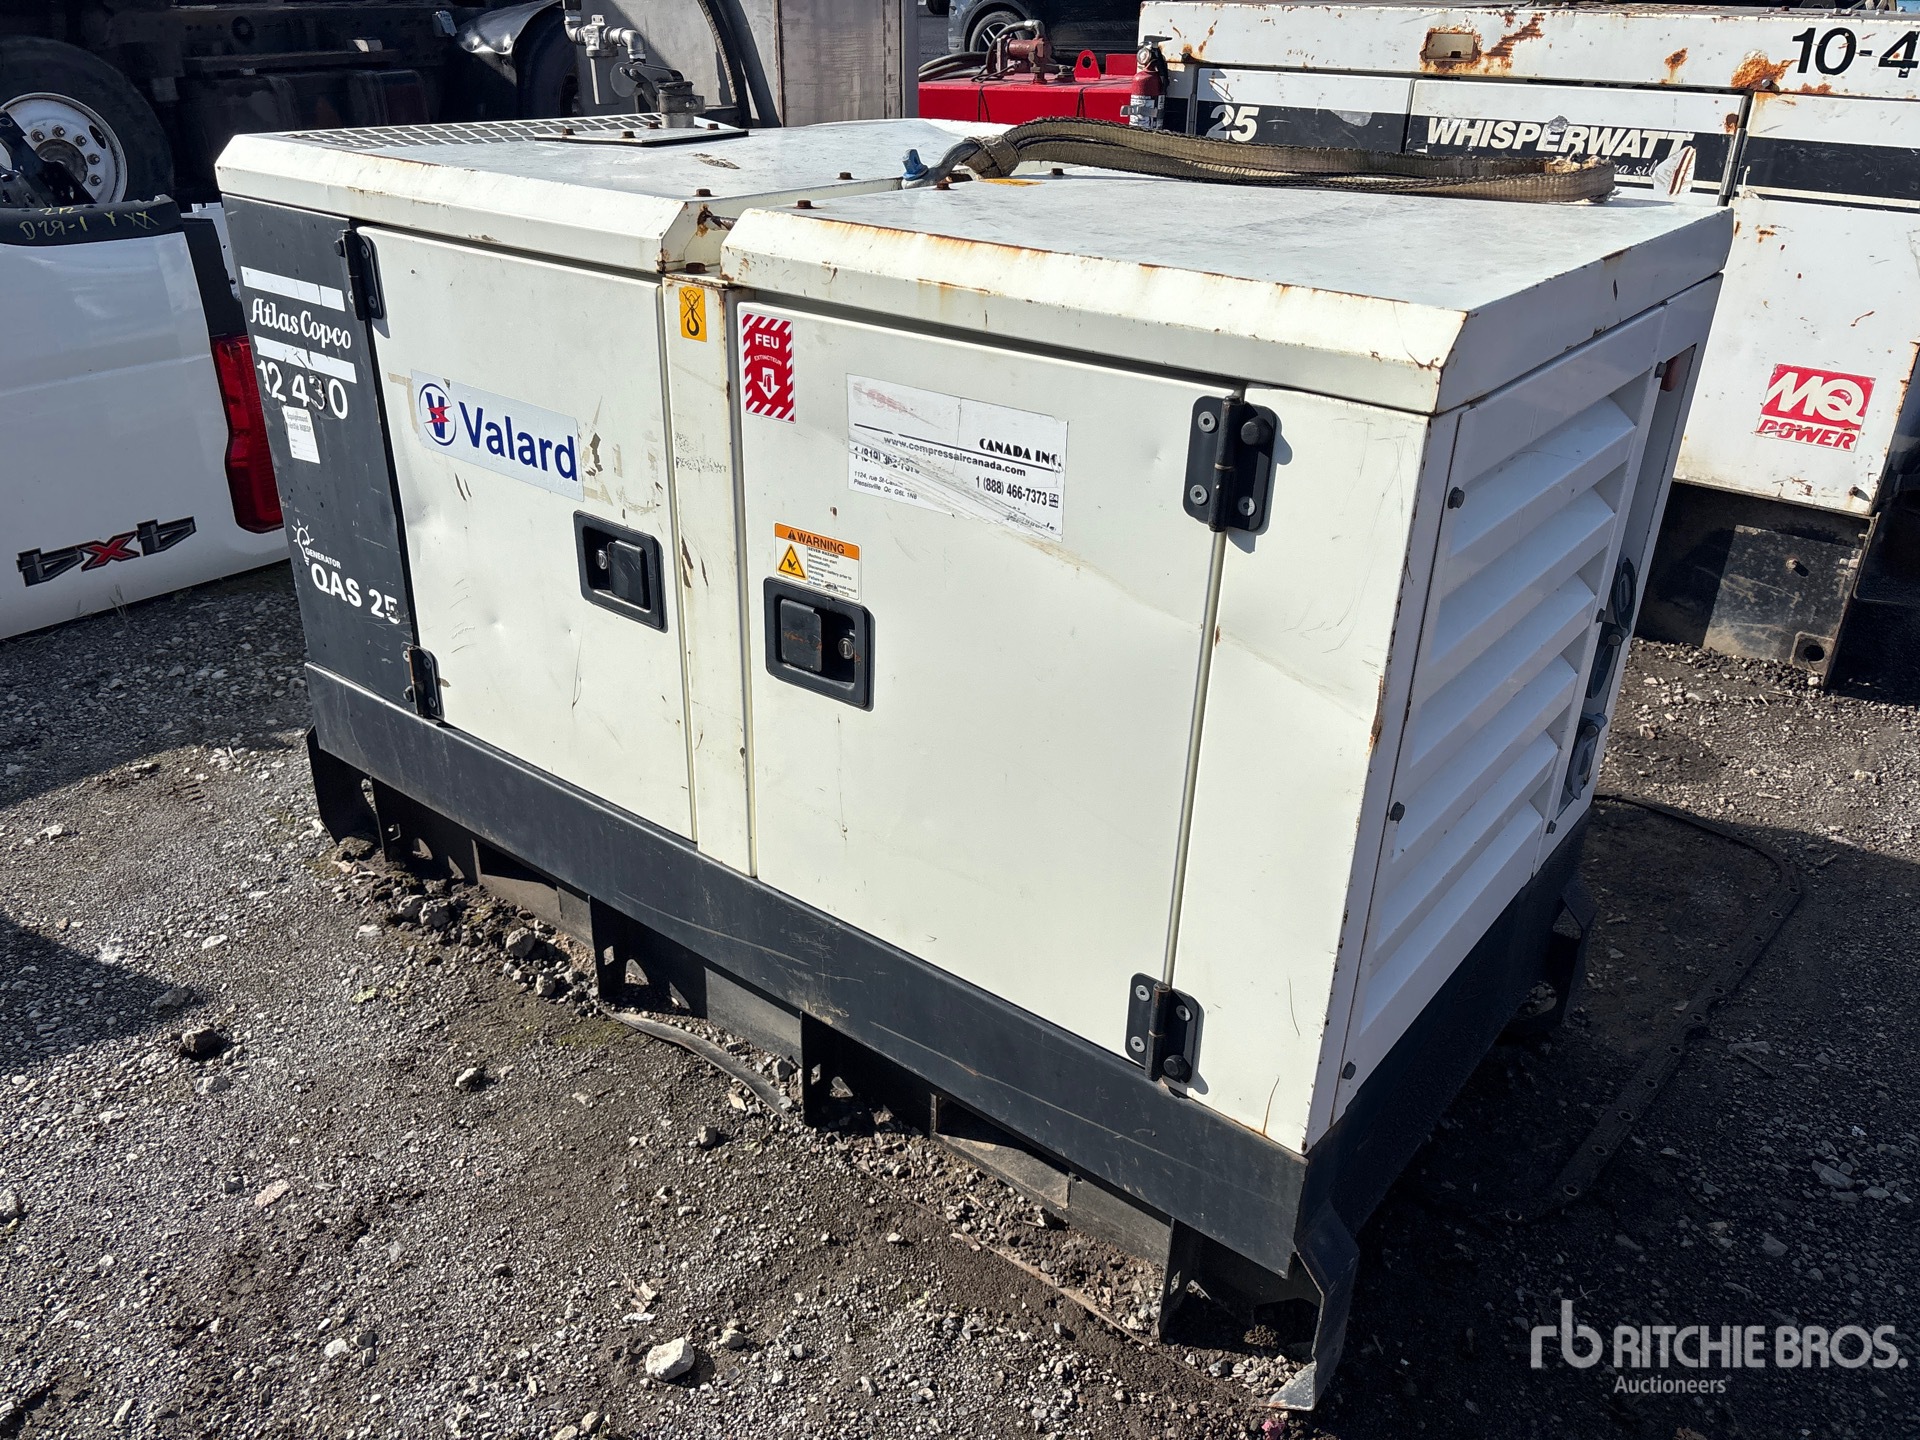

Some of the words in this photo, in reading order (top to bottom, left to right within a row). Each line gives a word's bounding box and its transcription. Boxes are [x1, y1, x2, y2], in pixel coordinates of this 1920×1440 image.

[1206, 104, 1260, 142] 25
[1427, 116, 1695, 159] WHISPERWATT
[250, 297, 299, 335] Atlas
[300, 310, 352, 349] Copco
[755, 333, 780, 349] FEU
[753, 354, 783, 366] EXTINCTEUR
[1762, 371, 1864, 425] MQ
[458, 401, 578, 481] Valard
[979, 437, 1032, 460] CANADA
[1755, 419, 1857, 450] POWER
[883, 437, 1026, 477] www.compressaircanada.com
[854, 470, 868, 481] 1124,
[868, 474, 878, 482] rue
[883, 485, 892, 494] Qc
[975, 475, 981, 489] 1
[983, 476, 1005, 495] (888)
[1006, 482, 1048, 506] 466-7373
[305, 547, 342, 569] GENERATOR
[797, 531, 845, 555] WARNING
[311, 563, 363, 608] QAS
[368, 588, 401, 624] 25
